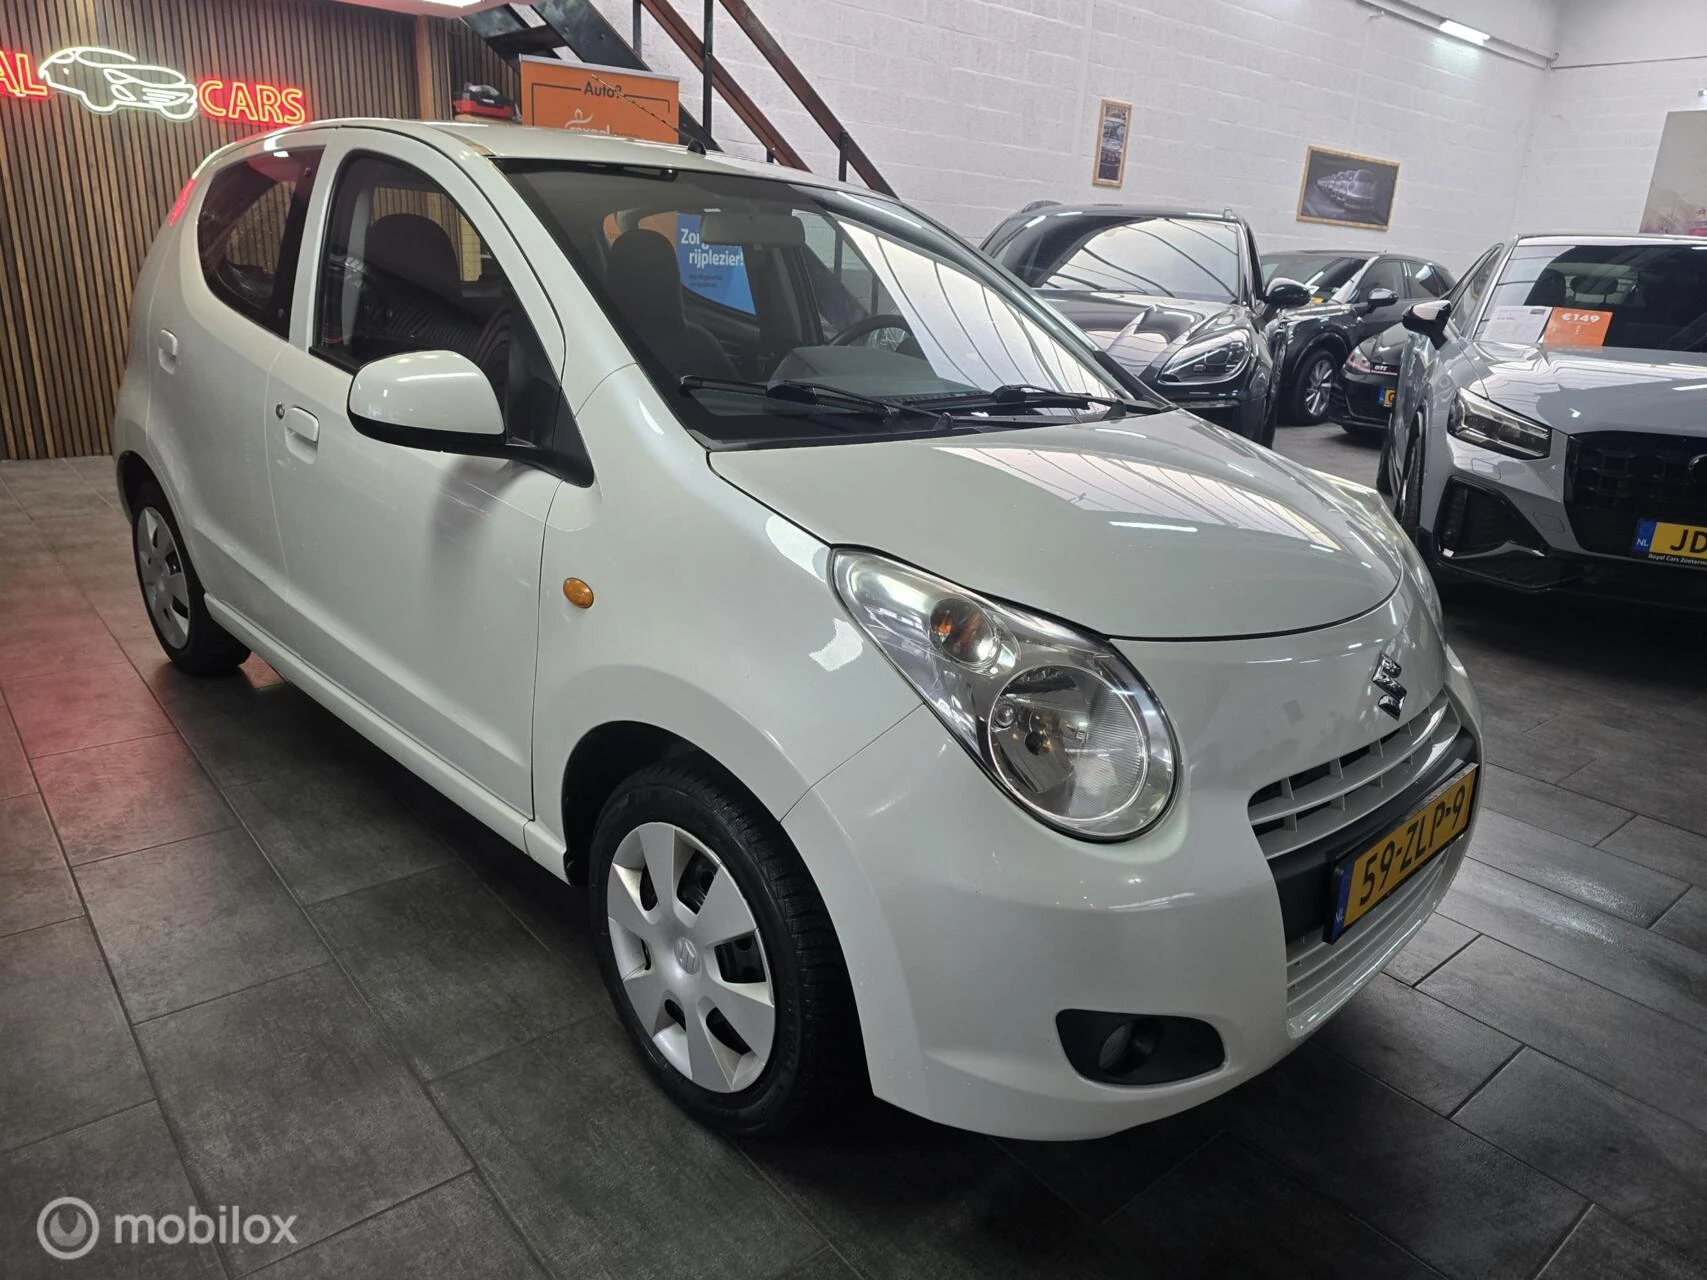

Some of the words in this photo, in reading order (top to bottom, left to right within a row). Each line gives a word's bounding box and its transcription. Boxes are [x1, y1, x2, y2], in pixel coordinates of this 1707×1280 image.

[584, 80, 622, 99] Auto?
[199, 79, 305, 125] CARS
[688, 249, 744, 268] rijplezier!
[1561, 312, 1601, 323] €149
[1636, 538, 1649, 547] NL
[1670, 529, 1707, 553] JD
[1360, 784, 1466, 907] 59-ZLP-9
